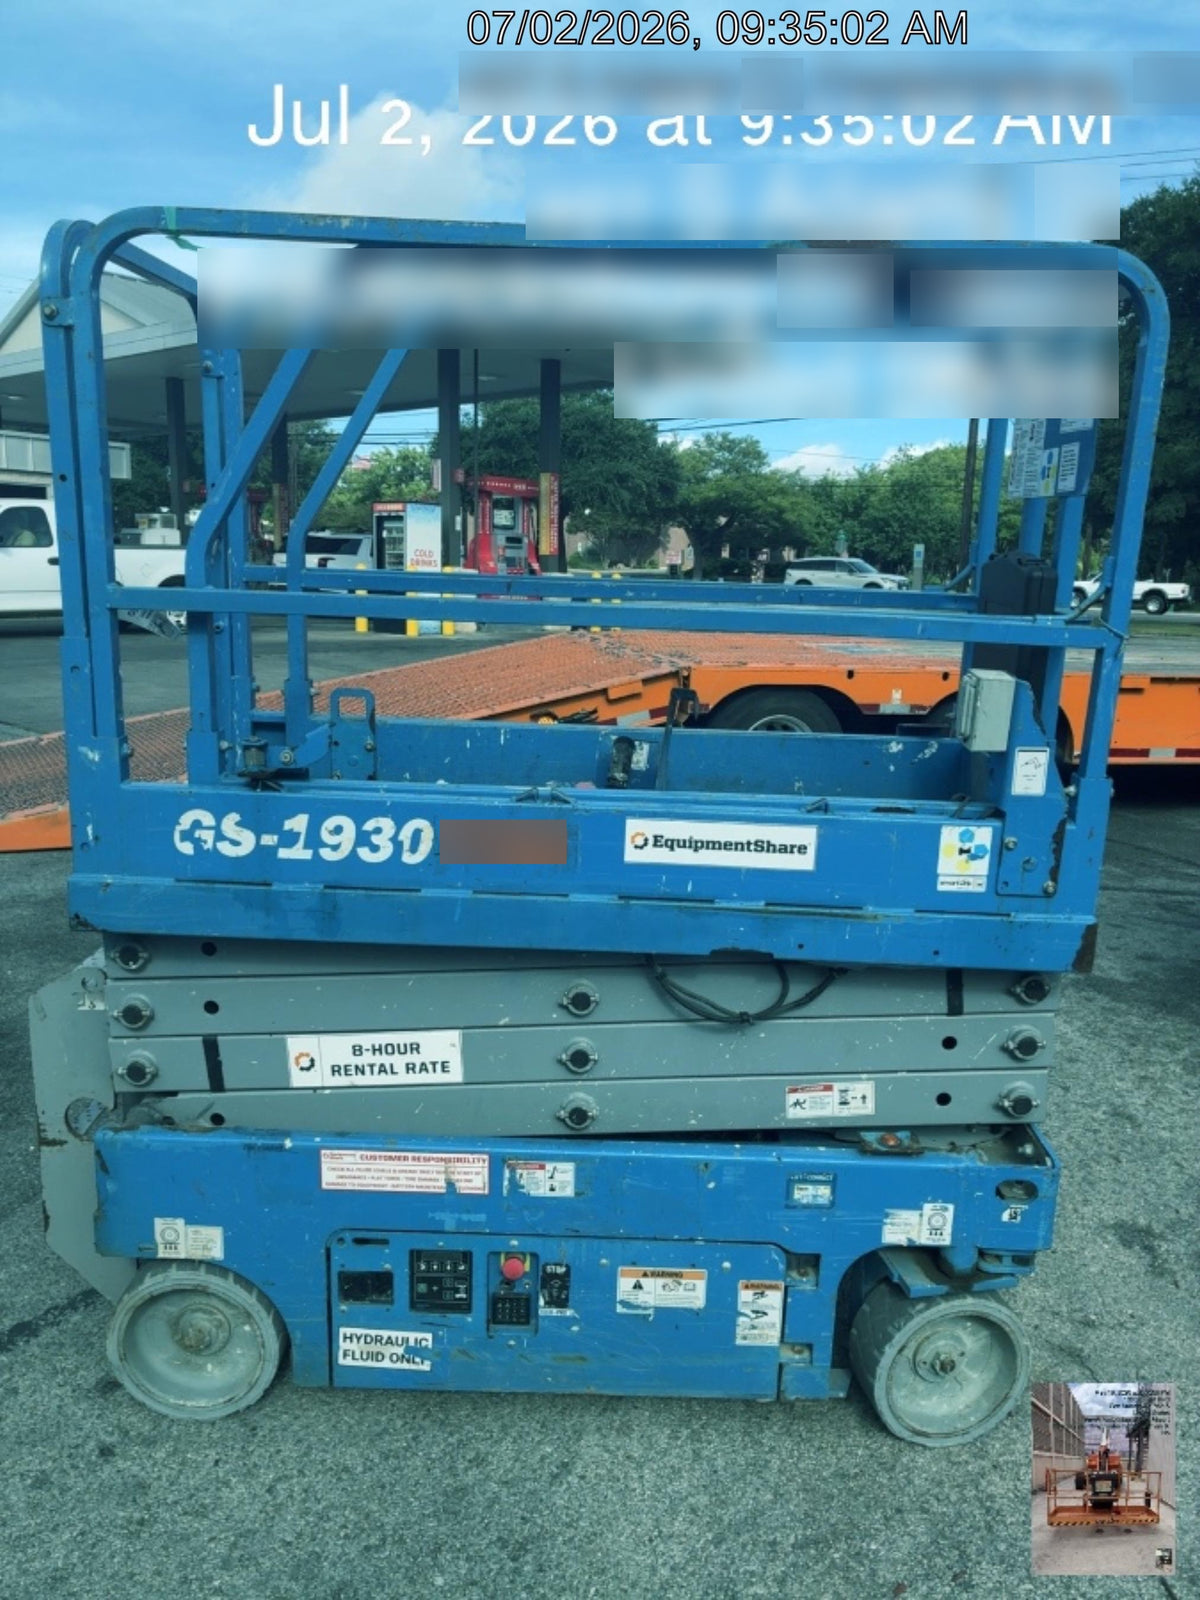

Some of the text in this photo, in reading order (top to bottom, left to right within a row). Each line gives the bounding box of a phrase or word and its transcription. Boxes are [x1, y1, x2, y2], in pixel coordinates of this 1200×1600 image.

[173, 808, 435, 865] GS-1930
[652, 834, 808, 855] EquipmentShare
[351, 1041, 421, 1057] 8-HOUR
[330, 1060, 451, 1077] RENTAL RATE
[360, 1154, 409, 1163] CUSTOMER
[342, 1349, 385, 1363] FLUID
